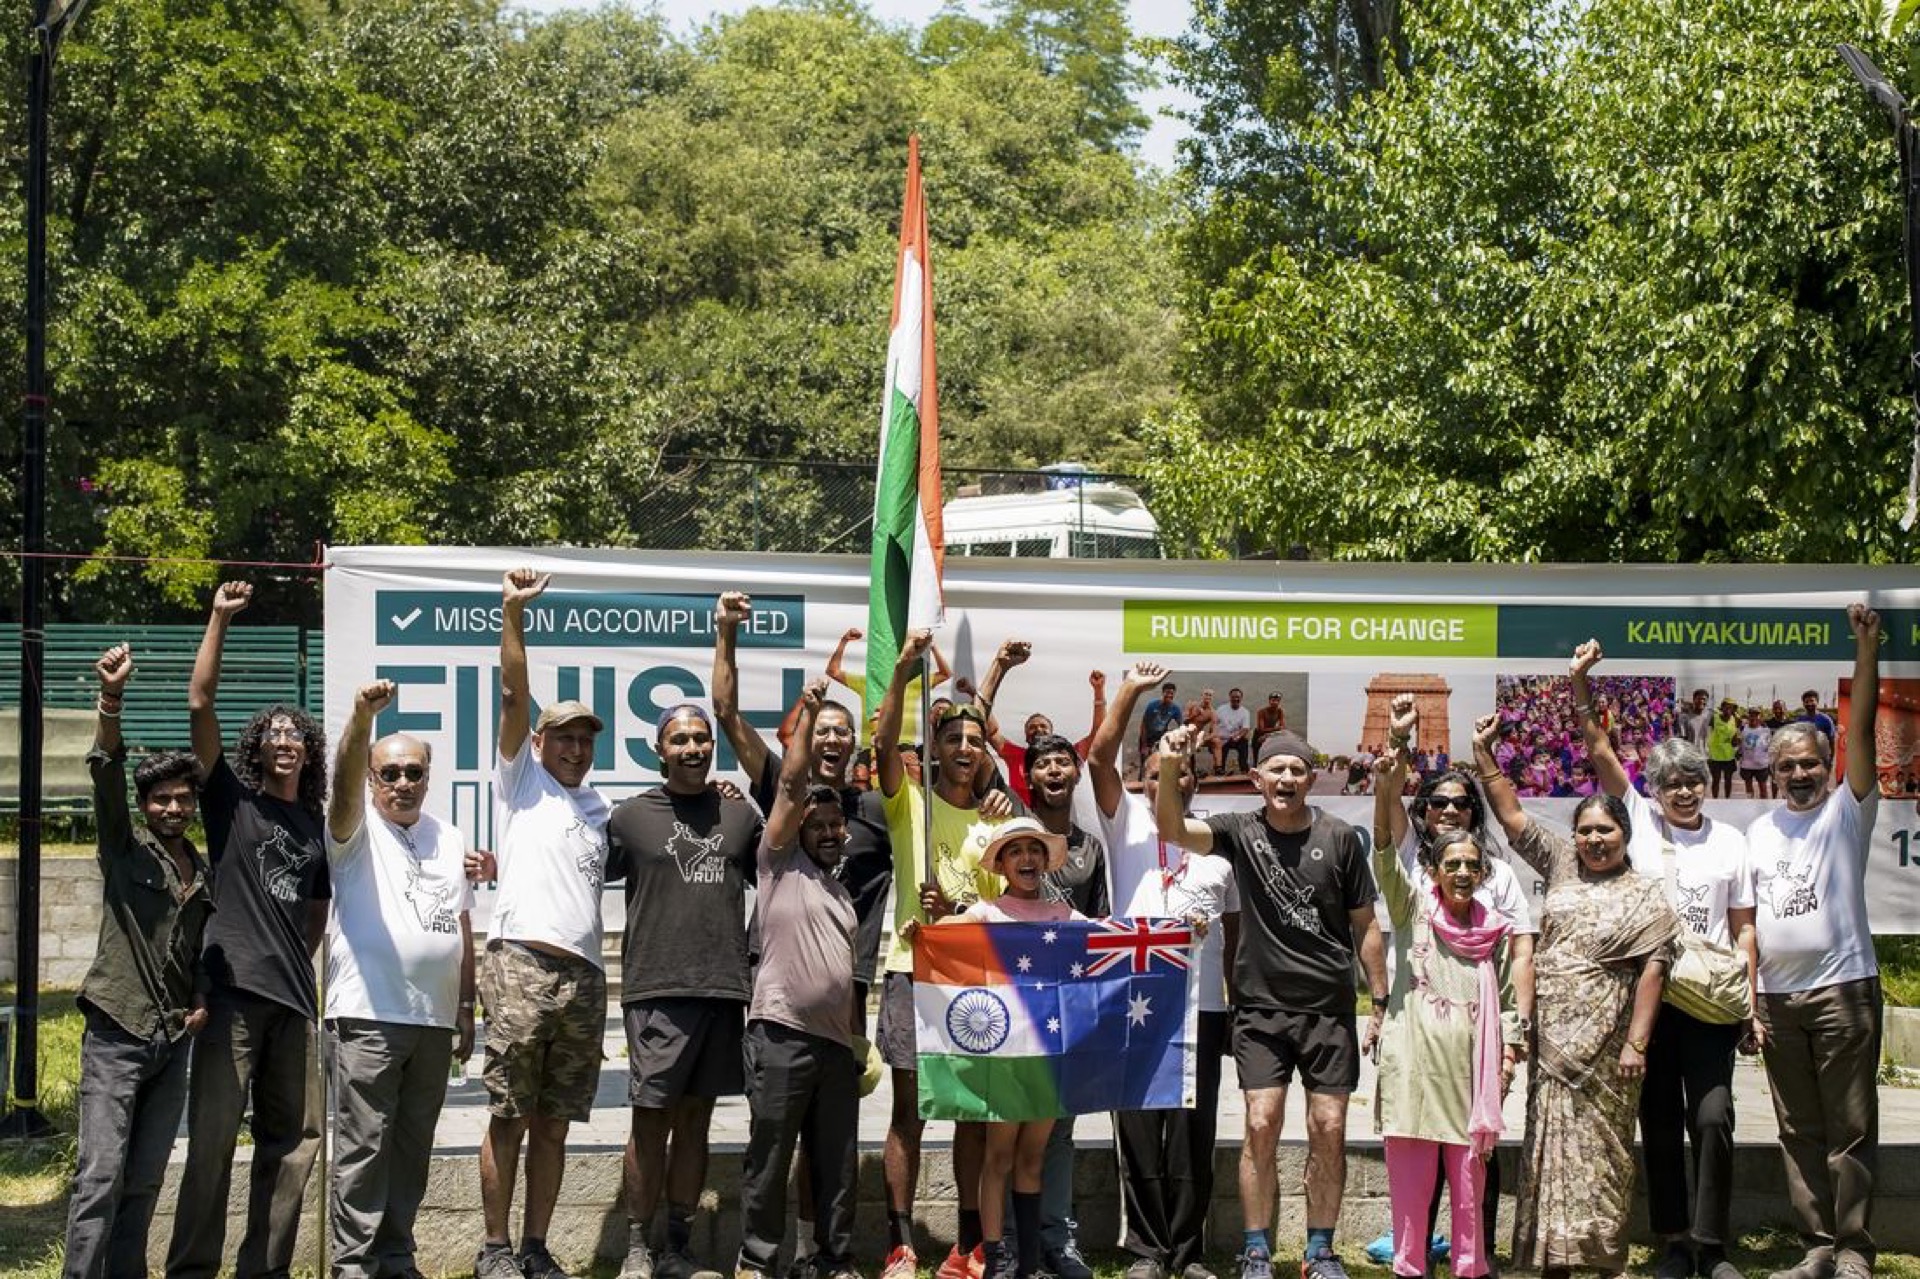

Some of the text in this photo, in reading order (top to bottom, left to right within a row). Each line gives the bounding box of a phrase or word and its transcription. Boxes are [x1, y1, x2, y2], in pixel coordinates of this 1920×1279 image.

[434, 606, 554, 633] MISSON
[1151, 615, 1464, 641] RUNNING FOR CHANGE
[1627, 620, 1830, 645] KANYAKUMARI
[693, 871, 724, 884] RUN
[1783, 899, 1818, 919] RUN
[432, 922, 458, 935] RUN
